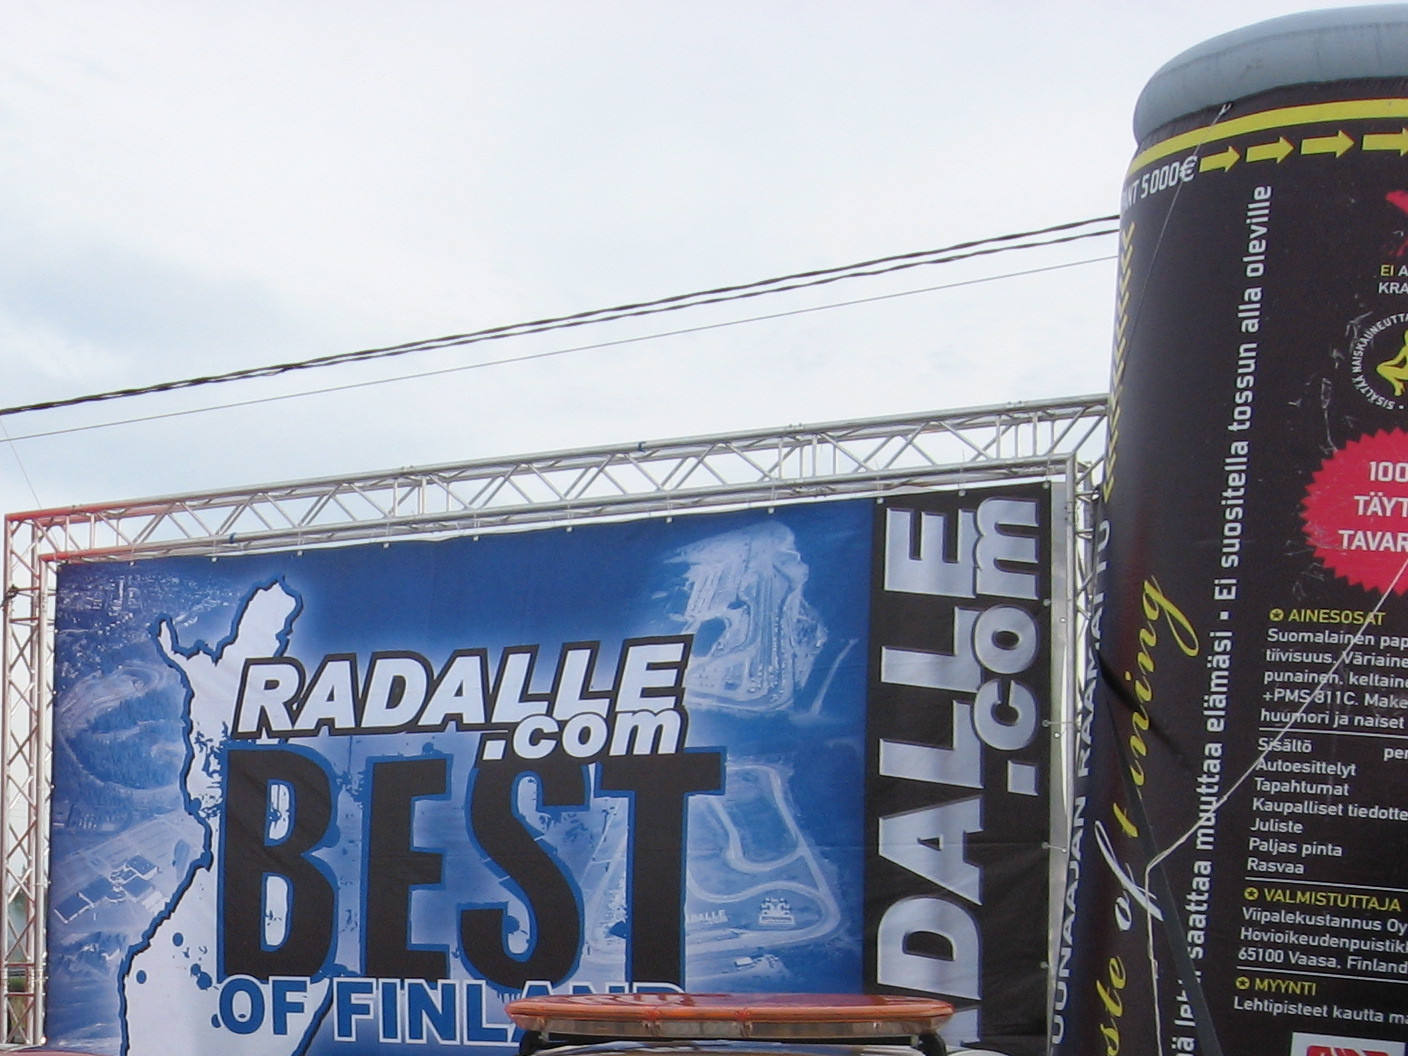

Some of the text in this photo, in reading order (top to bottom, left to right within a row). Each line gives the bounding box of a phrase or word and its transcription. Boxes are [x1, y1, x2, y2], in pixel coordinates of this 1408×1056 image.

[1140, 154, 1199, 199] 5000€
[1380, 264, 1394, 277] EI
[1214, 184, 1272, 602] Ei suositella tossun alla oleville
[1288, 608, 1386, 626] AINESOSAT
[973, 495, 1044, 796] .com
[1267, 627, 1375, 646] Suomalainen
[234, 637, 693, 736] RADALLE
[1203, 630, 1233, 733] elämäsi
[1262, 687, 1312, 703] +PMS
[1112, 574, 1200, 838] tuning
[1260, 707, 1405, 730] huumori ja naiset
[482, 706, 684, 761] .com
[1257, 737, 1313, 753] Sisältö
[877, 506, 984, 1046] DALLE
[1255, 757, 1357, 779] Autoesittelyt
[1195, 742, 1223, 851] muuttaa
[1254, 777, 1350, 796] Tapahtumat
[1252, 797, 1344, 816] Kaupalliset
[1249, 817, 1304, 834] Juliste
[1248, 836, 1343, 858] Paljas pinta
[218, 745, 725, 992] BEST
[1094, 820, 1165, 932] of
[1246, 857, 1305, 875] Rasvaa
[1186, 859, 1212, 960] saattaa
[1263, 887, 1402, 912] VALMISTUTTAJA
[1242, 906, 1408, 937] Viipalekustannus Oy
[1238, 947, 1284, 964] 65100
[1346, 955, 1408, 974] Finland
[1254, 977, 1317, 996] MYYNTI
[218, 976, 686, 1047] OF FINL
[1233, 995, 1329, 1018] Lehtipisteet
[1332, 1004, 1384, 1023] kautta
